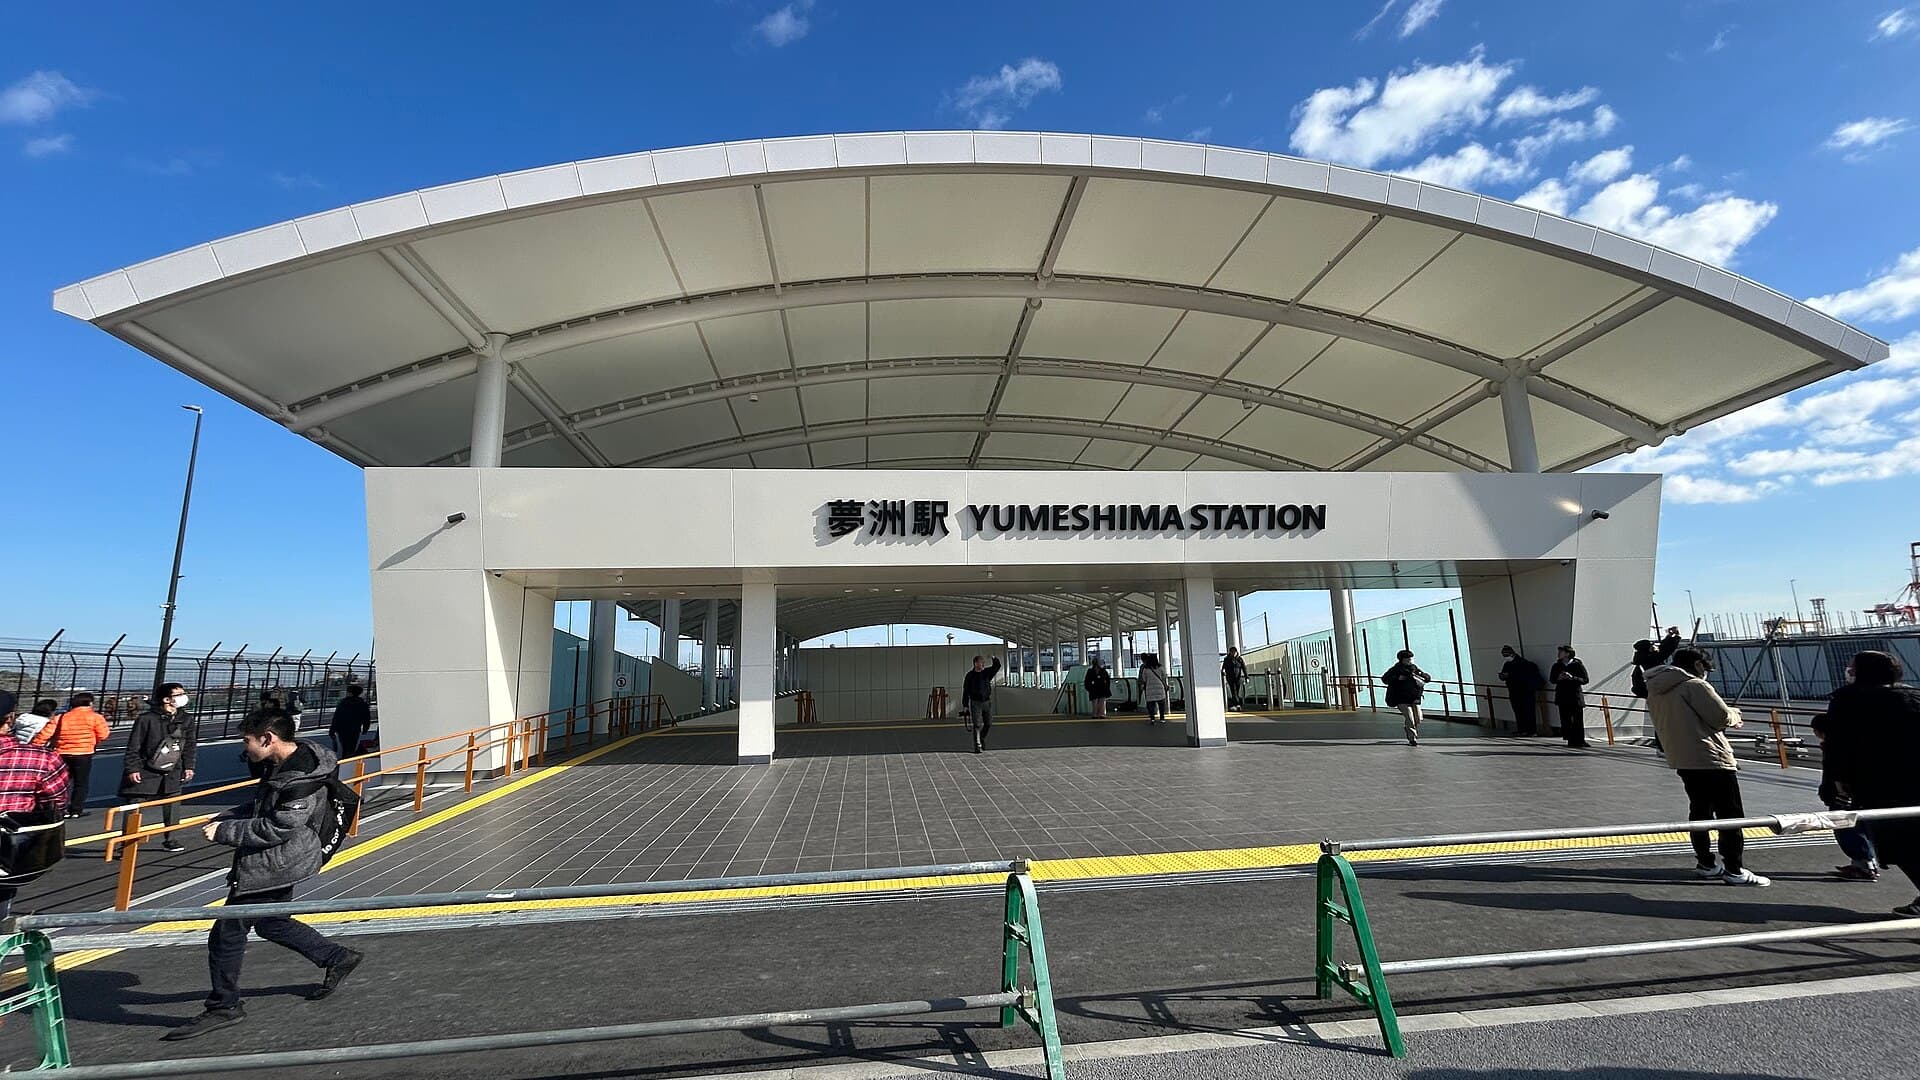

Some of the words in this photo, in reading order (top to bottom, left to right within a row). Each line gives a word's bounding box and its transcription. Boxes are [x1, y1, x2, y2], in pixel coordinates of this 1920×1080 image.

[826, 499, 949, 537] 夢洲駅
[966, 504, 1185, 531] YUMESHIMA
[1189, 504, 1326, 531] STATION
